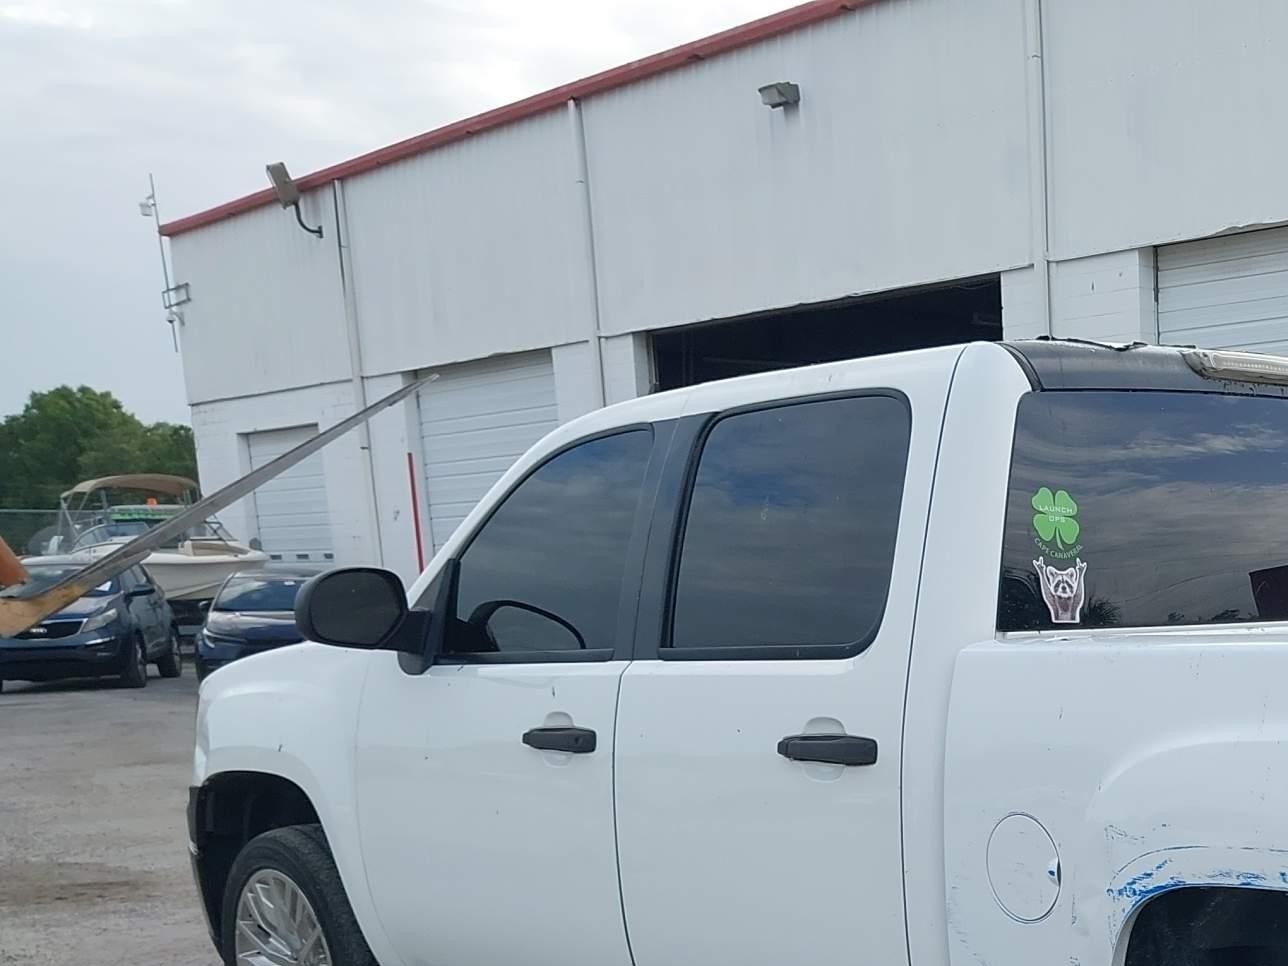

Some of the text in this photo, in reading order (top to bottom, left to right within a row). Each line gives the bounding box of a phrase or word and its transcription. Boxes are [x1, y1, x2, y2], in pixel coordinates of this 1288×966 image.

[1039, 504, 1073, 513] LAUNCH
[1049, 515, 1066, 523] OPS
[1034, 537, 1049, 554] CAPE
